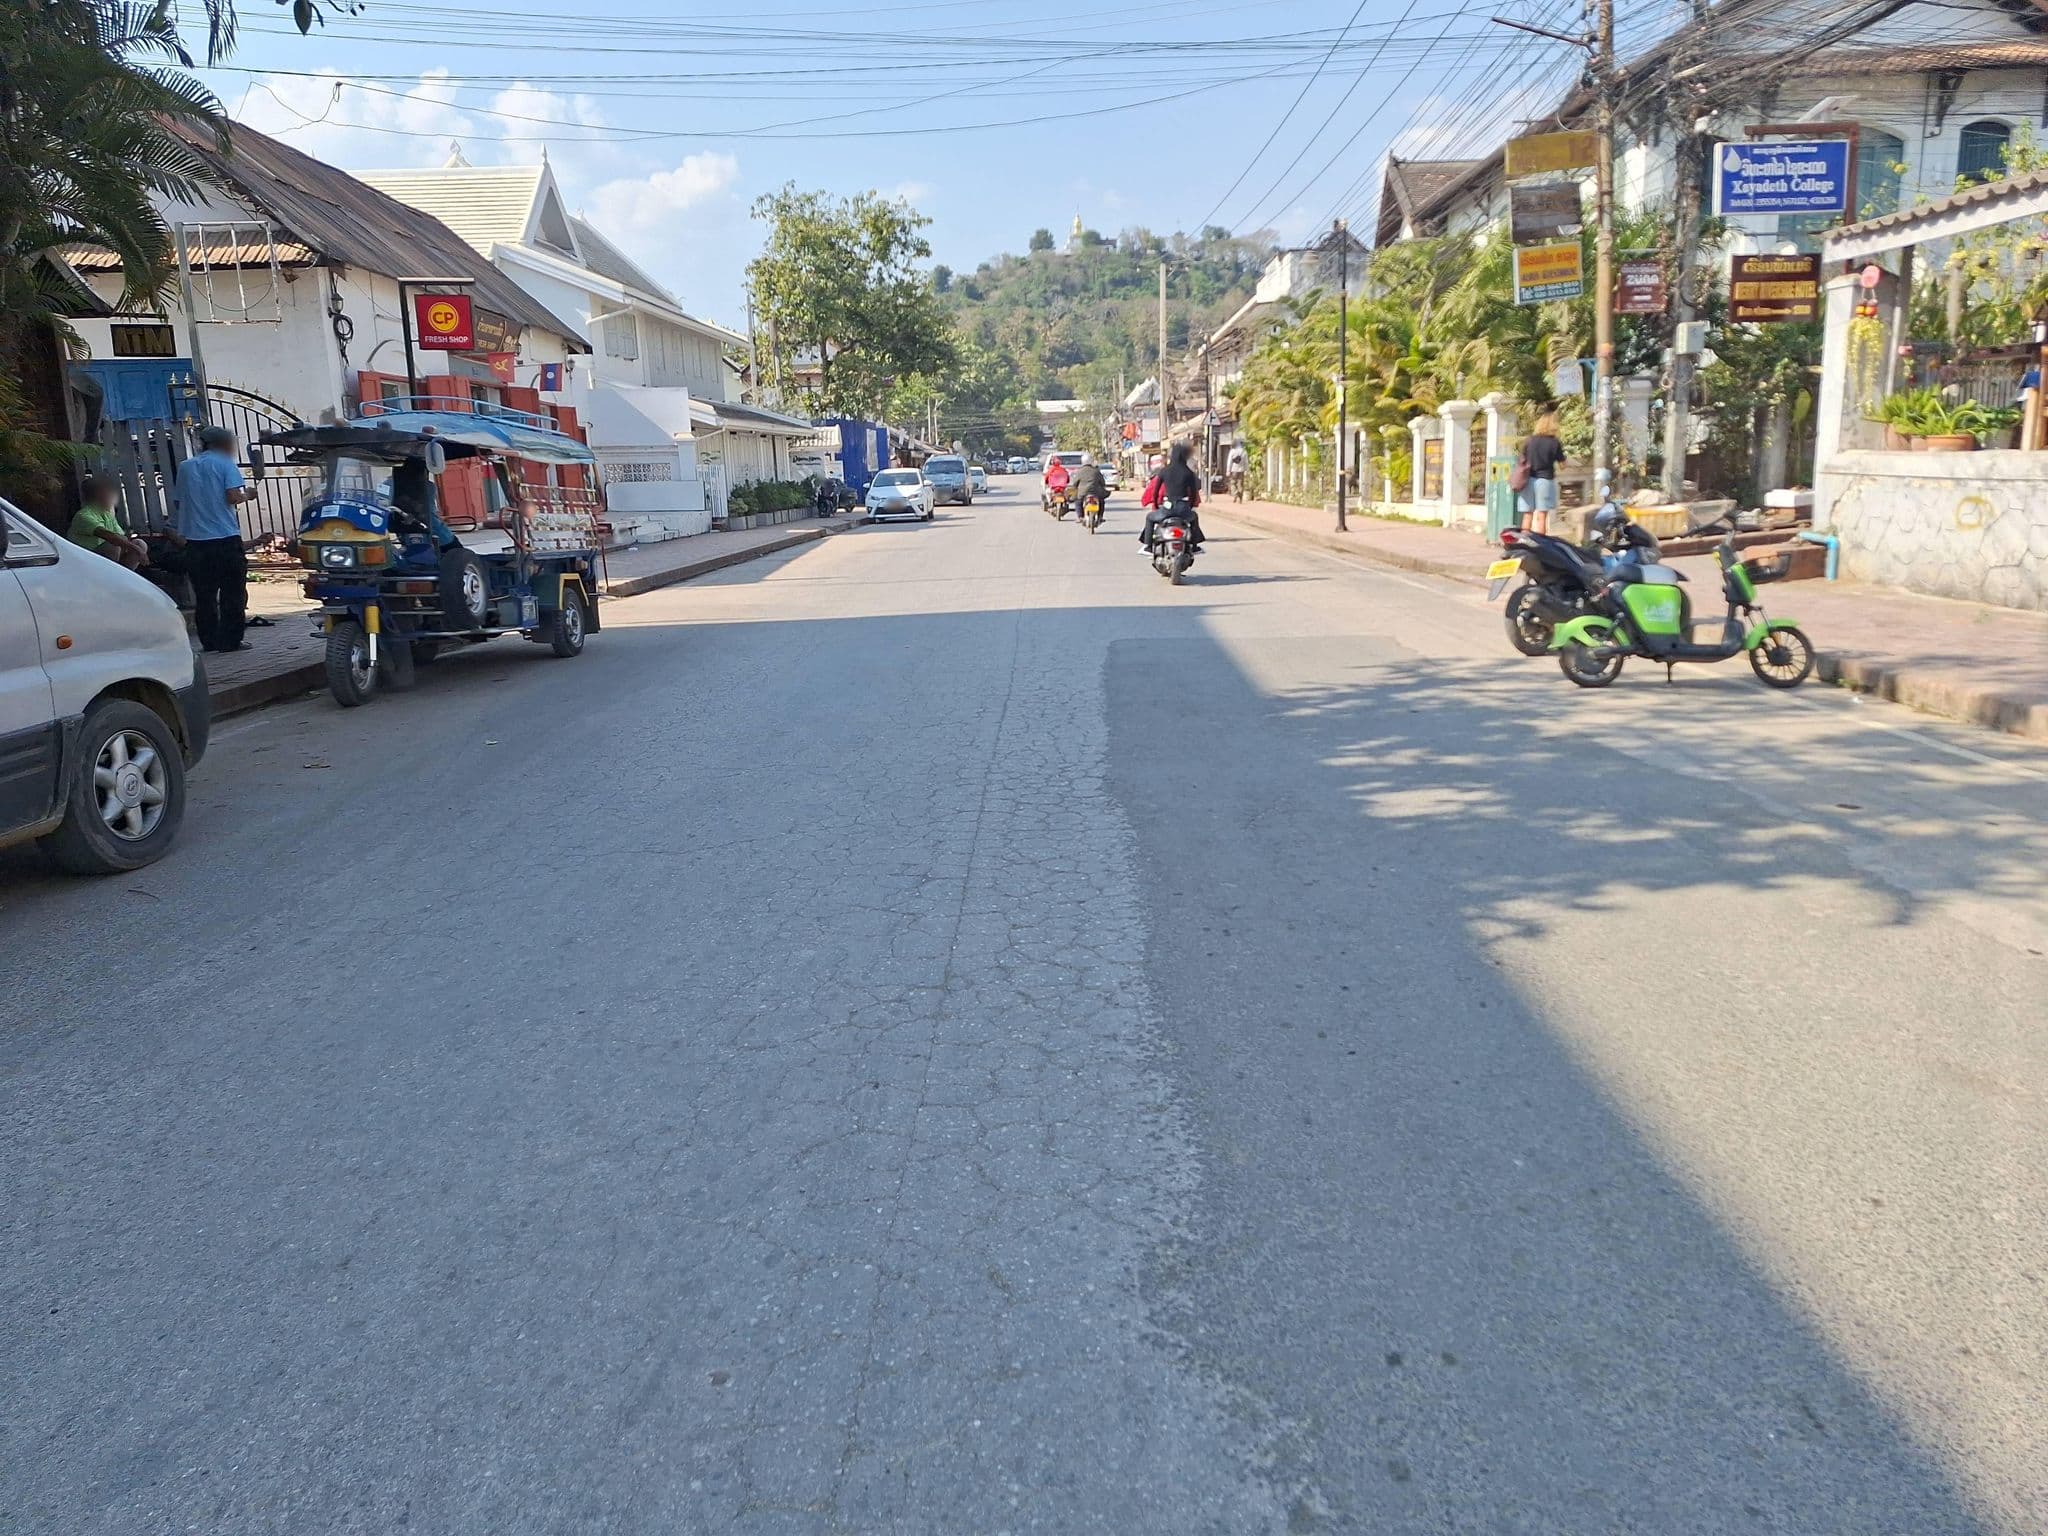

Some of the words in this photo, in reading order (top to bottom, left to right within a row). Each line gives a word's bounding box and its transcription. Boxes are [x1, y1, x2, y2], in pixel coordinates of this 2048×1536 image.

[1731, 178, 1788, 195] Xayadeth
[1791, 177, 1835, 193] College
[432, 311, 454, 324] CP
[115, 326, 173, 353] ATM
[424, 335, 448, 343] FRESH
[448, 335, 469, 343] SHOP
